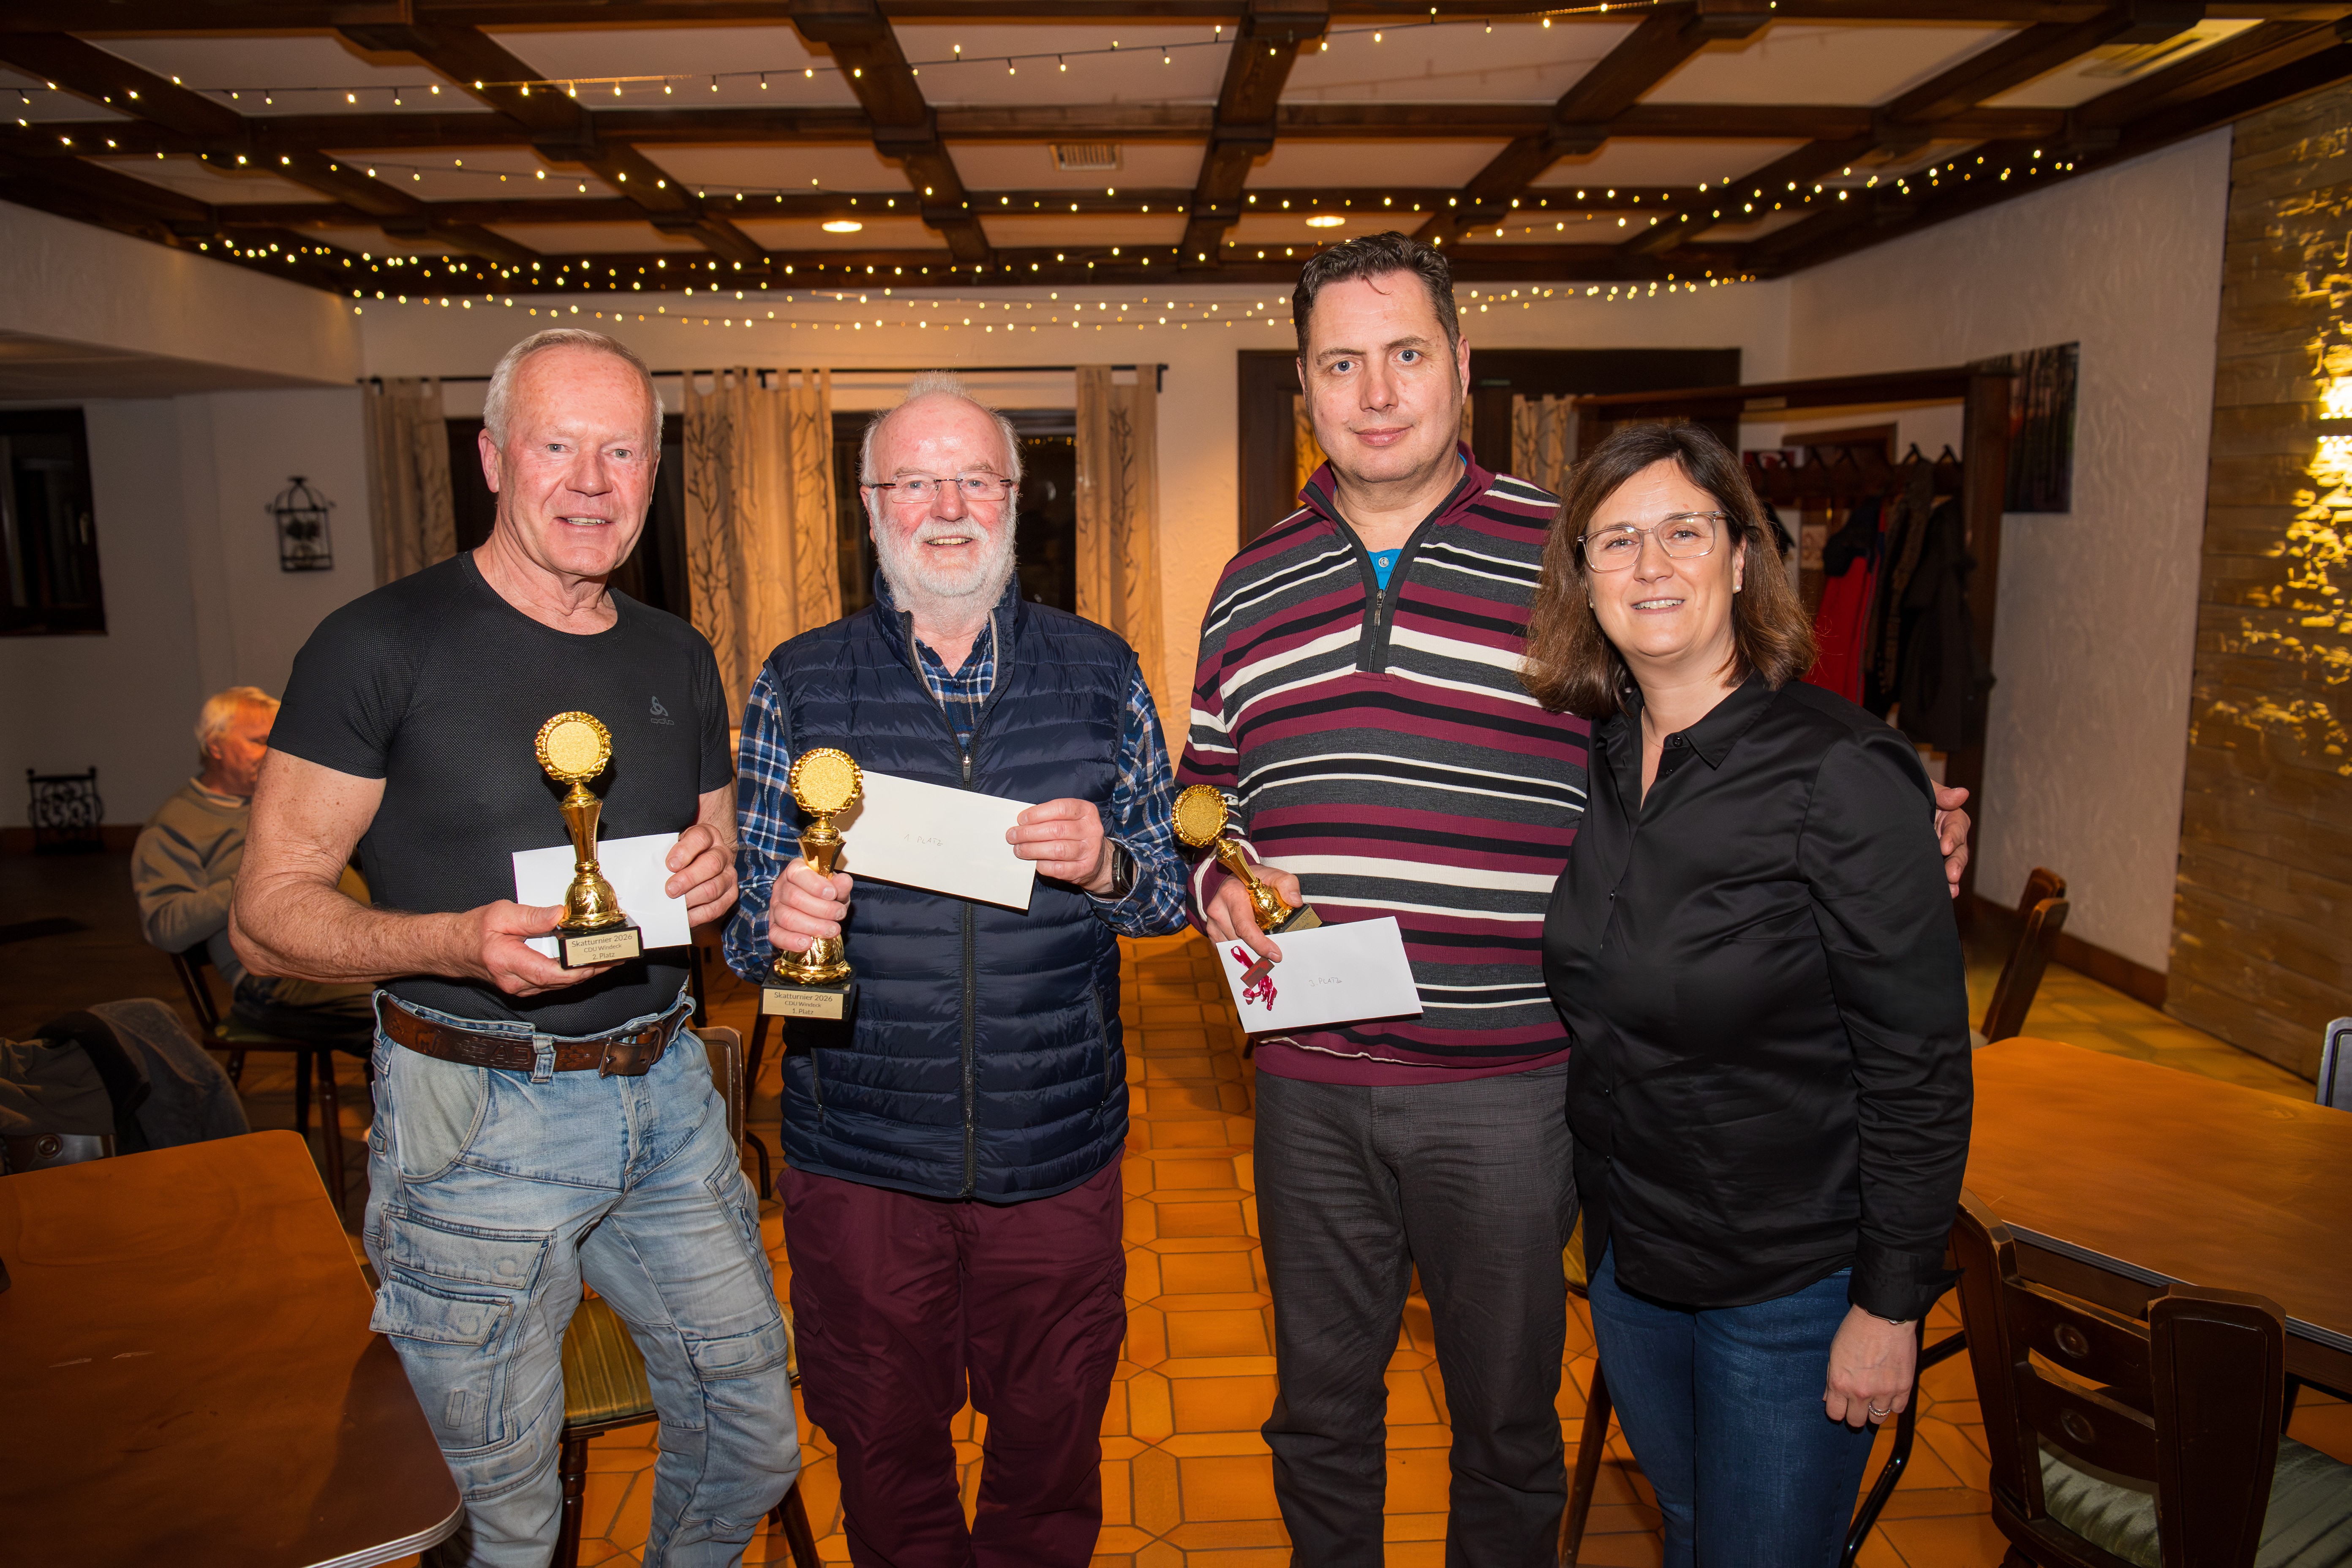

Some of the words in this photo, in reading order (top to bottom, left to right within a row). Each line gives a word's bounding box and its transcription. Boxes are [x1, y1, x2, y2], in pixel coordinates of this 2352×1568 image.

[917, 836, 943, 847] PLATZ
[572, 937, 612, 947] Skatturnier
[614, 934, 633, 942] 2026
[598, 943, 622, 951] Windeck
[774, 992, 813, 1001] Skatturnier
